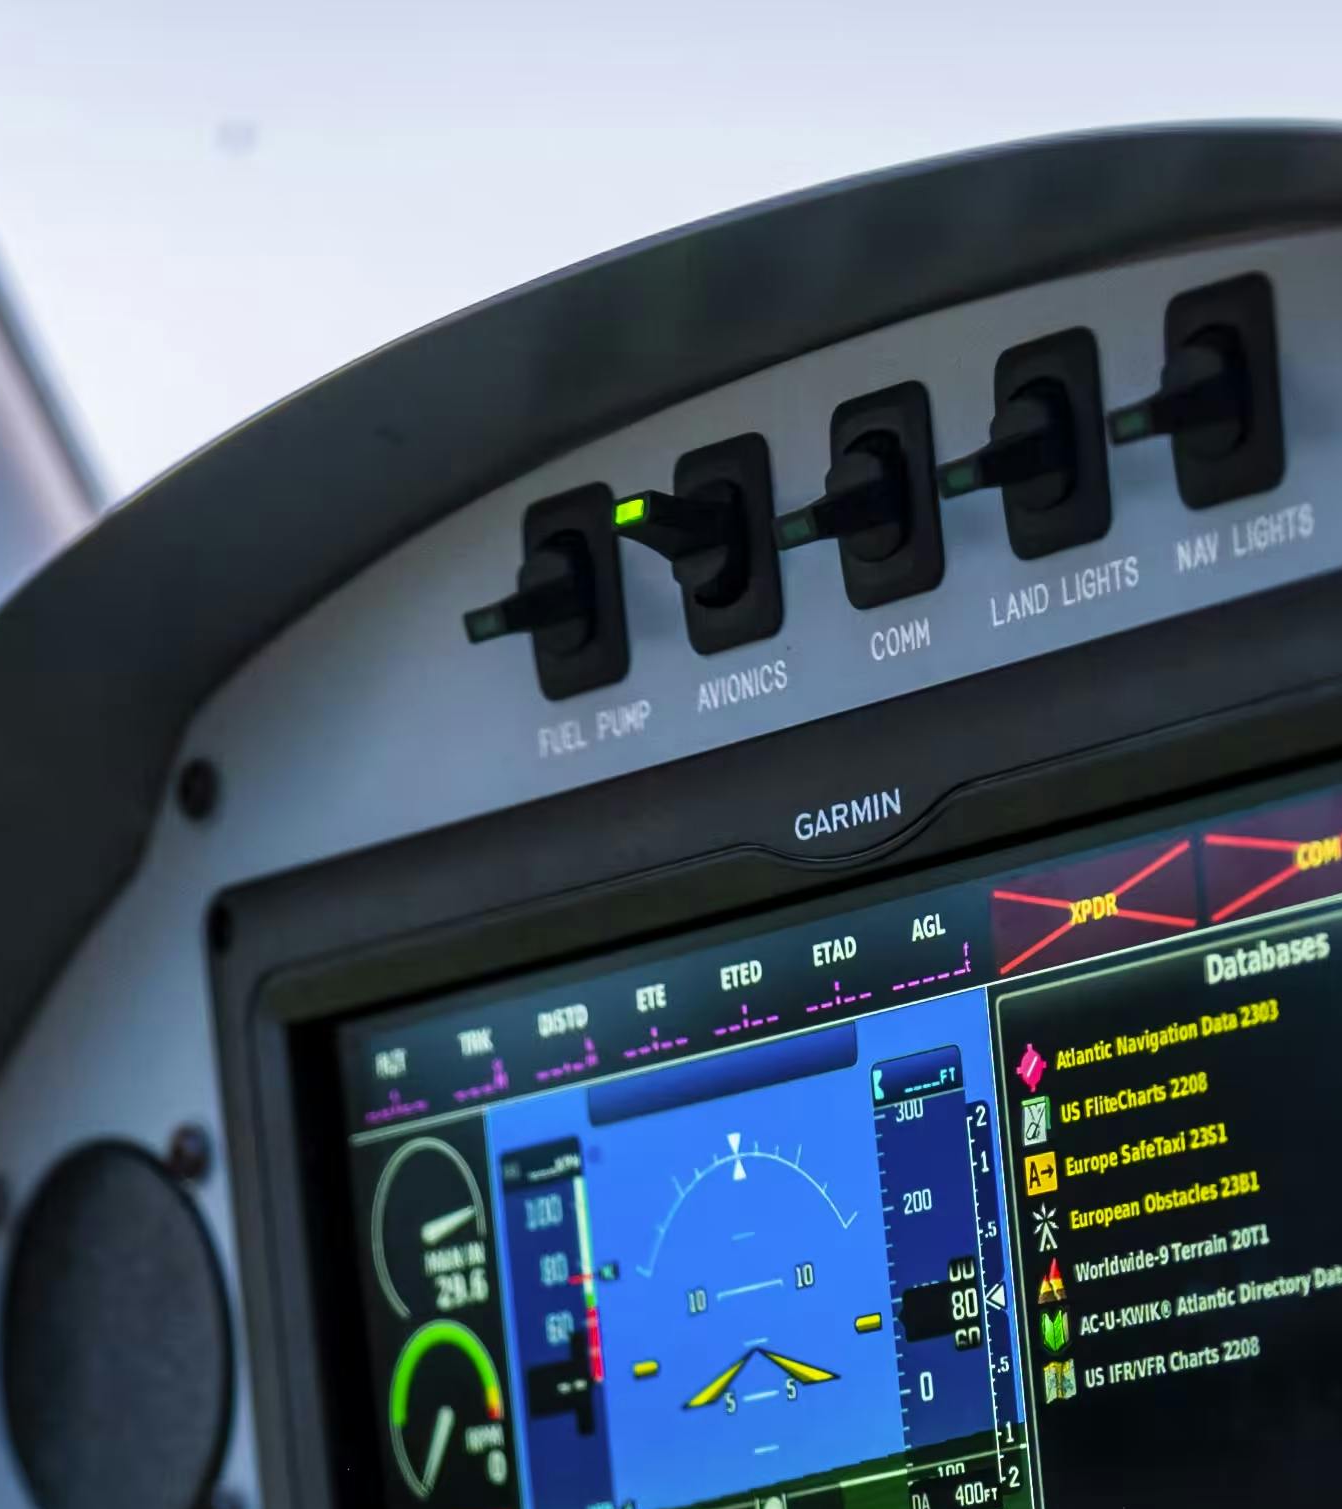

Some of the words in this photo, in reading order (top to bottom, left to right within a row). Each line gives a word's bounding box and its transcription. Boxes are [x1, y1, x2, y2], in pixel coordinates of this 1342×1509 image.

[1176, 532, 1219, 573] NAV
[1232, 504, 1315, 556] LIGHTS
[990, 583, 1049, 627] LAND
[1061, 556, 1140, 606] LIGHTS
[870, 618, 931, 662] COMM
[696, 660, 789, 713] AVIONICS
[538, 720, 588, 759] FUEL
[595, 700, 652, 742] PUMP
[794, 787, 902, 842] GARMIN
[1294, 838, 1342, 871] COM
[1068, 892, 1118, 926] XPDR
[911, 913, 946, 942] AGL
[812, 935, 857, 967] ETAD
[1204, 931, 1331, 985] Databases
[720, 960, 763, 991] ETED
[635, 983, 667, 1013] ETE
[1056, 1040, 1112, 1070] Atlantic
[1116, 1022, 1198, 1056] Navigation
[1201, 1010, 1238, 1036] Data
[1240, 999, 1279, 1029] 2303
[1060, 1103, 1080, 1123] US
[1086, 1083, 1167, 1118] FliteCharts
[1170, 1072, 1208, 1099] 2208
[975, 1105, 987, 1127] 2
[980, 1150, 990, 1173] 1
[1065, 1152, 1118, 1176] Europe
[1121, 1131, 1186, 1165] SafeTaxi
[1190, 1122, 1228, 1149] 23S1
[903, 1188, 932, 1215] 200
[1070, 1201, 1140, 1229] European
[1144, 1182, 1218, 1213] Obstacles
[983, 1221, 997, 1238] .5
[1075, 1245, 1170, 1283] Worldwide-9
[1171, 1234, 1227, 1262] Terrain
[795, 1262, 815, 1289] 10
[687, 1288, 707, 1315] 10
[952, 1287, 978, 1321] 80
[1177, 1286, 1236, 1317] Atlantic
[1240, 1270, 1311, 1305] Directory
[996, 1356, 1010, 1373] .5
[1085, 1366, 1105, 1389] US
[1109, 1354, 1167, 1384] IFR/VFR
[1169, 1345, 1219, 1372] Charts
[1223, 1336, 1260, 1362] 2208
[724, 1391, 737, 1413] 5
[787, 1379, 797, 1401] 5
[919, 1371, 934, 1402] 0
[1005, 1421, 1014, 1443] 1
[1009, 1466, 1020, 1488] 2
